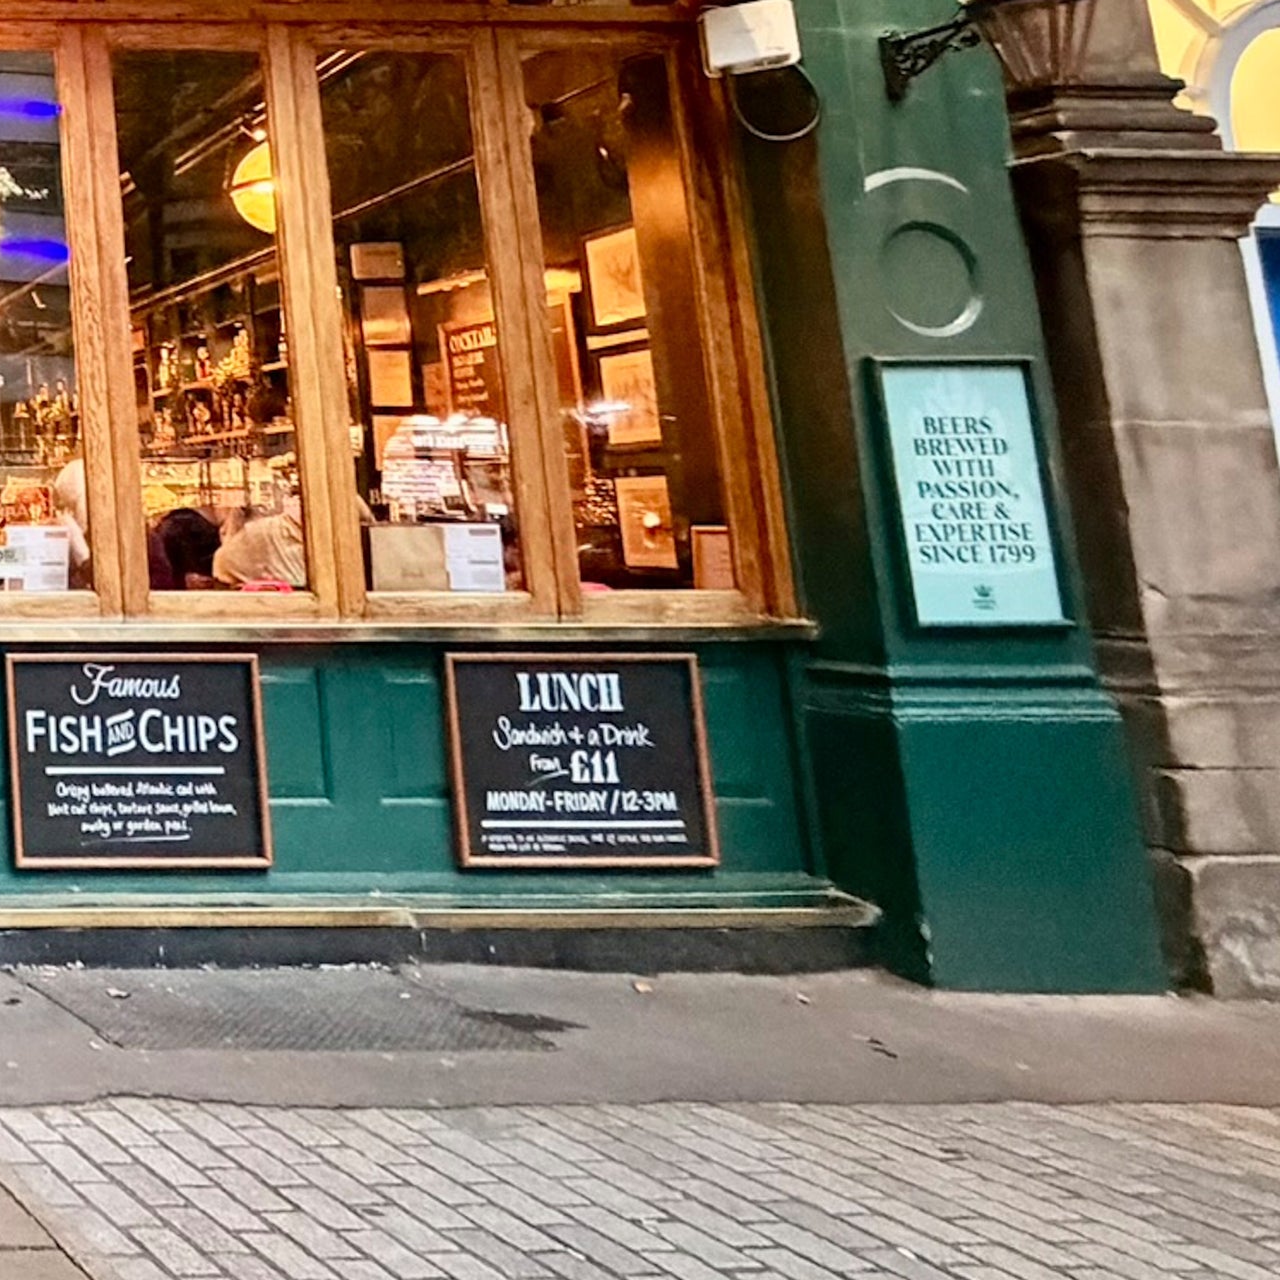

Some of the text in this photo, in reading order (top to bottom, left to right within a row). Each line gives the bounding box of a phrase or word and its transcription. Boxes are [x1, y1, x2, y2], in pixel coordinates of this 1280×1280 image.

[922, 416, 993, 435] BEERS
[913, 438, 1008, 456] BREWED
[932, 459, 995, 477] WITH
[918, 480, 1021, 500] PASSION,
[932, 502, 1012, 520] CARE &
[915, 523, 1035, 543] EXPERTISE
[919, 545, 1037, 563] SINCE 1799
[70, 663, 181, 705] Famous
[516, 673, 625, 712] LUNCH
[25, 708, 239, 753] FISH AND CHIPS
[492, 716, 656, 751] Sandwich + a Drink
[569, 750, 621, 784] £11
[621, 791, 678, 813] 12-3PM
